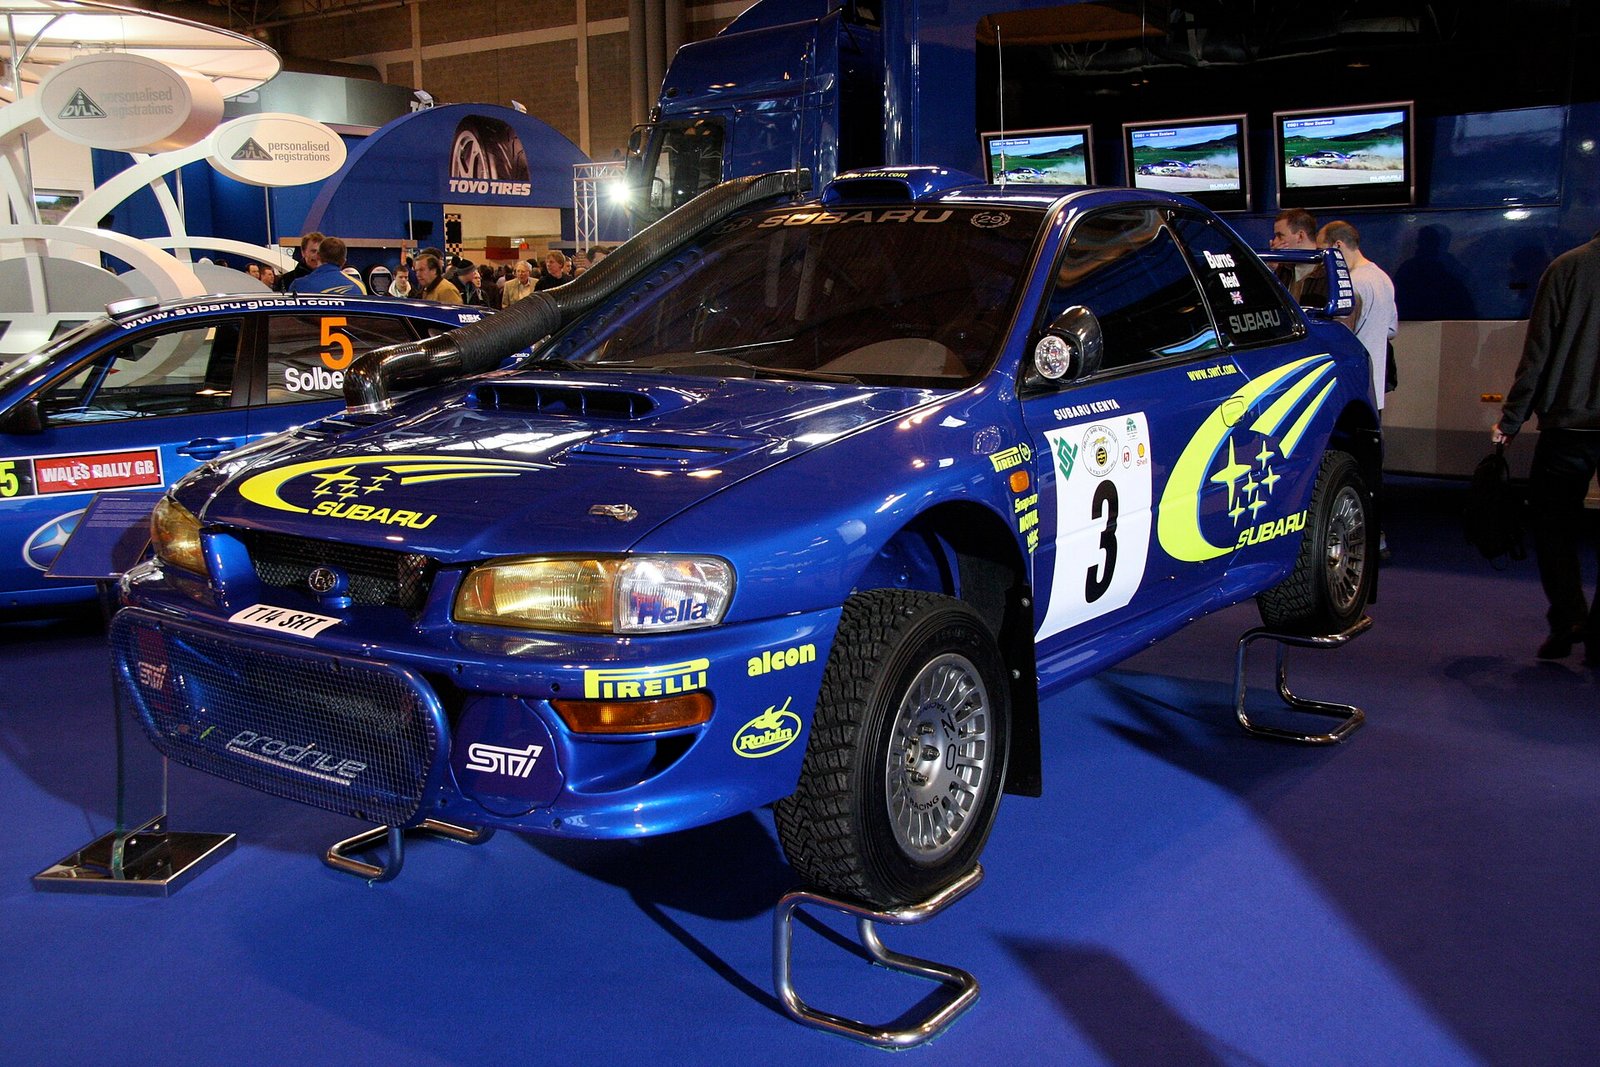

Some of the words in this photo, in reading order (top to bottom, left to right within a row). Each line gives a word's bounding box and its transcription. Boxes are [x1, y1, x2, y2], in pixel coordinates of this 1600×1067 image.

[62, 104, 102, 117] DVLA
[268, 141, 330, 152] personalised
[274, 151, 331, 163] registrations
[449, 180, 489, 194] TOYO
[490, 181, 532, 196] TIRES
[757, 210, 953, 228] SUBARU
[1203, 250, 1236, 269] Burns
[1219, 271, 1241, 289] Reid
[122, 298, 345, 330] www.subaru-global.com
[1229, 308, 1281, 334] SUBARU
[320, 316, 354, 370] 5
[285, 366, 345, 392] Solbe
[1186, 363, 1238, 381] www.swrt.com
[1053, 403, 1091, 421] SUBARU
[1089, 398, 1121, 414] KENYA
[42, 463, 91, 484] WALES
[91, 461, 132, 479] RALLY
[134, 460, 155, 475] GB
[989, 446, 1022, 473] PIRELLI
[0, 460, 19, 497] 5
[312, 500, 438, 530] SUBARU
[1084, 479, 1119, 604] 3
[1235, 509, 1307, 550] SUBARU
[278, 614, 330, 632] SRT
[637, 598, 709, 625] Hella
[747, 643, 817, 677] alcon
[583, 657, 711, 699] PIRELLI
[738, 726, 794, 751] Robin
[226, 730, 368, 779] prodrive
[909, 794, 940, 811] RACING
